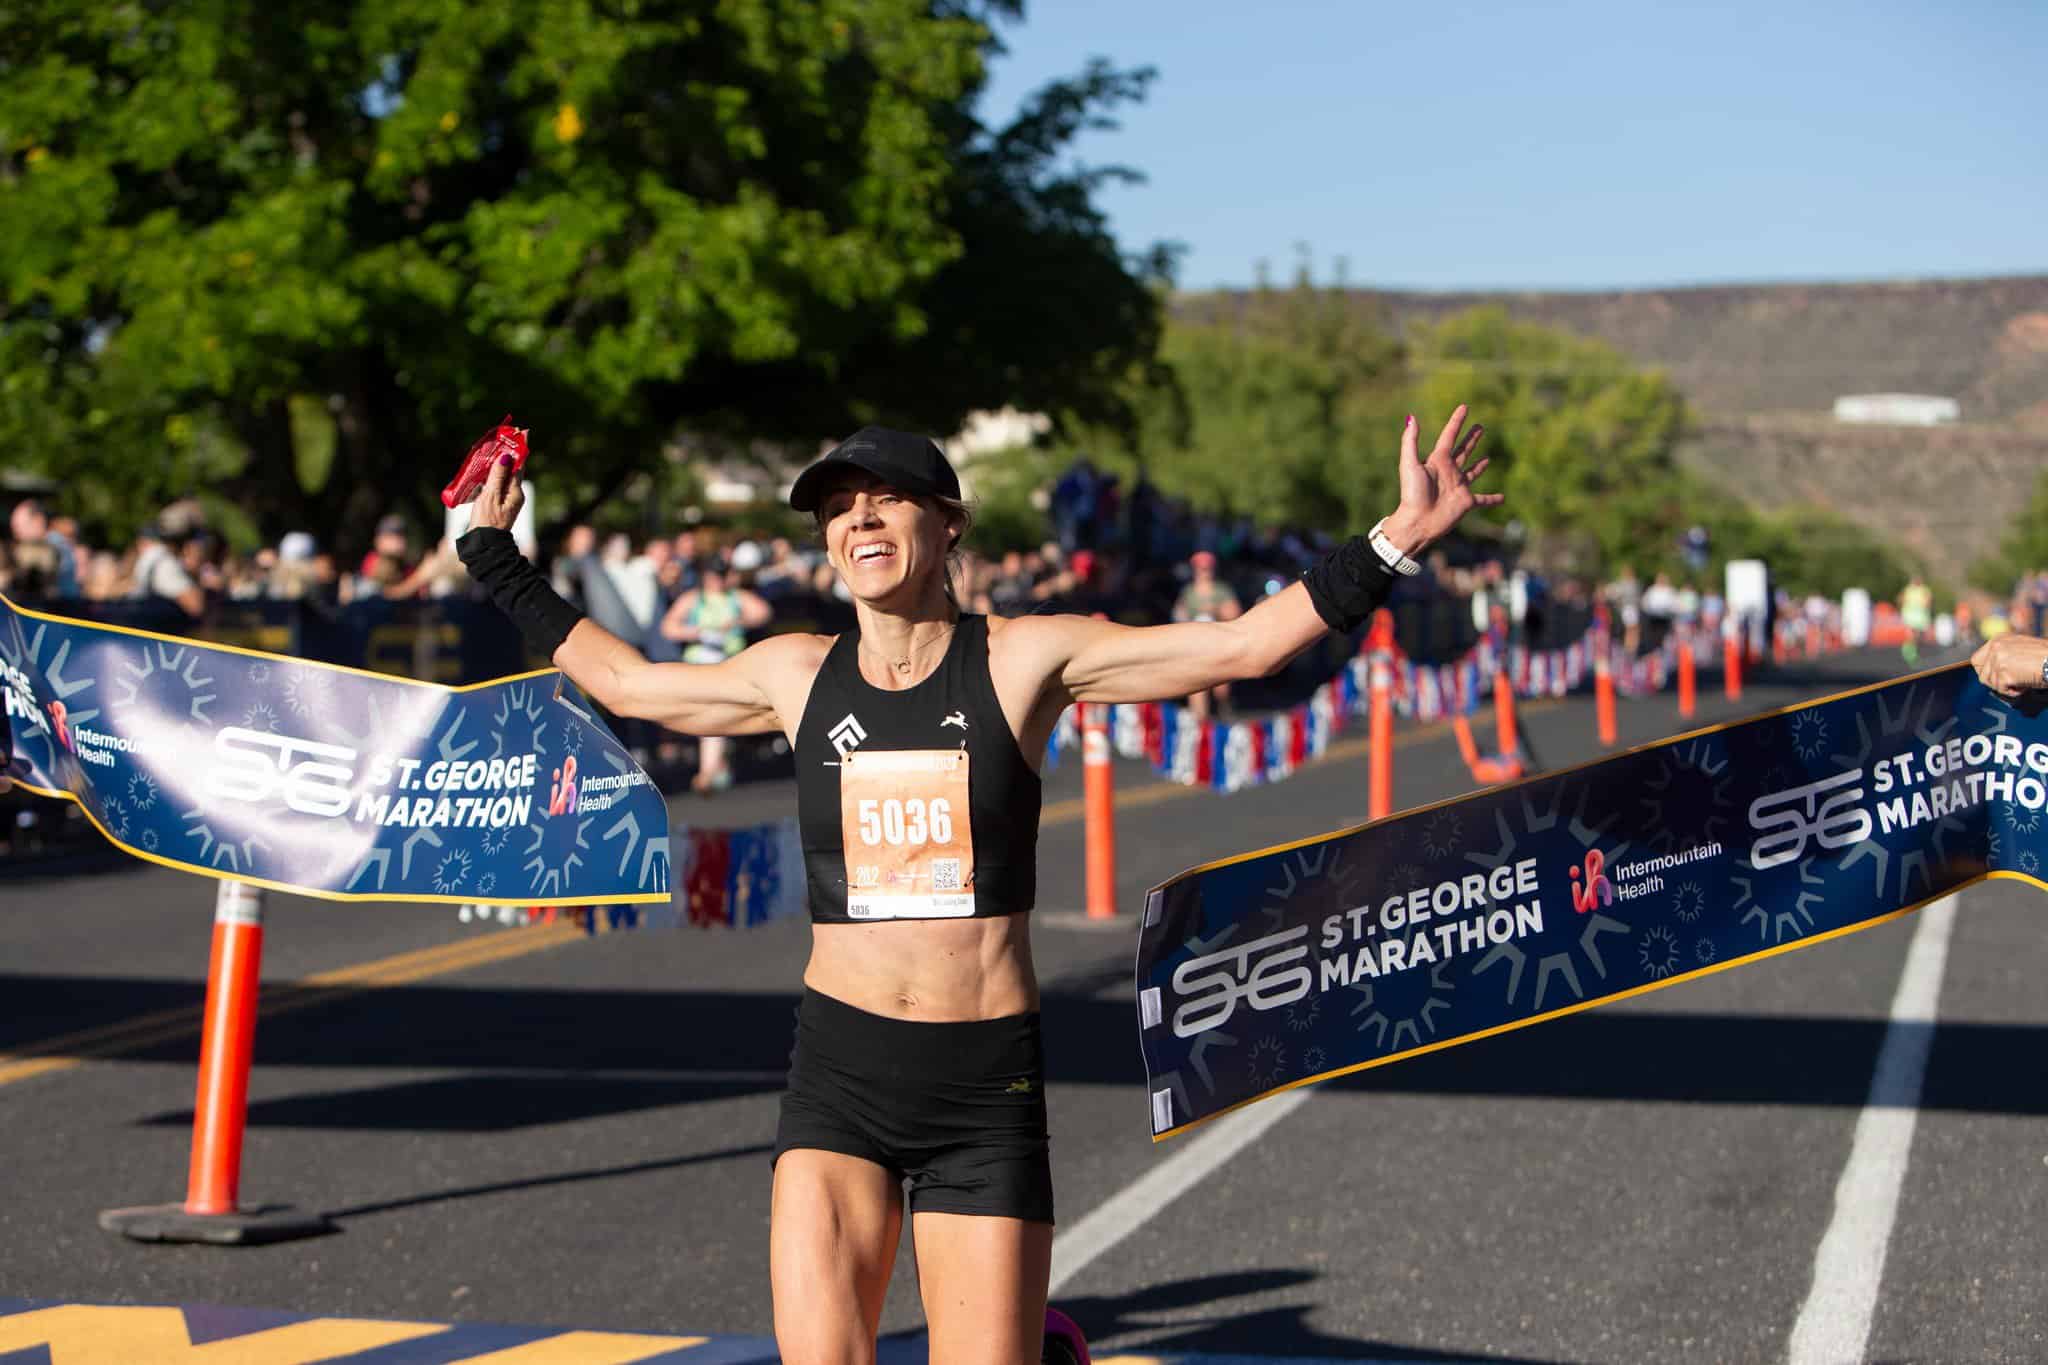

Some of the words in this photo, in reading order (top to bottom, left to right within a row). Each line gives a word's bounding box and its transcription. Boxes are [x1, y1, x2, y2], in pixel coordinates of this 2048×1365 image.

[77, 743, 115, 768] Health
[355, 791, 532, 827] MARATHON
[577, 793, 612, 816] Health
[858, 798, 952, 845] 5036
[1877, 771, 2048, 834] MARATHO
[1616, 841, 1722, 882] Intermountain
[1618, 875, 1664, 901] Health
[1319, 899, 1543, 992] MARATHON
